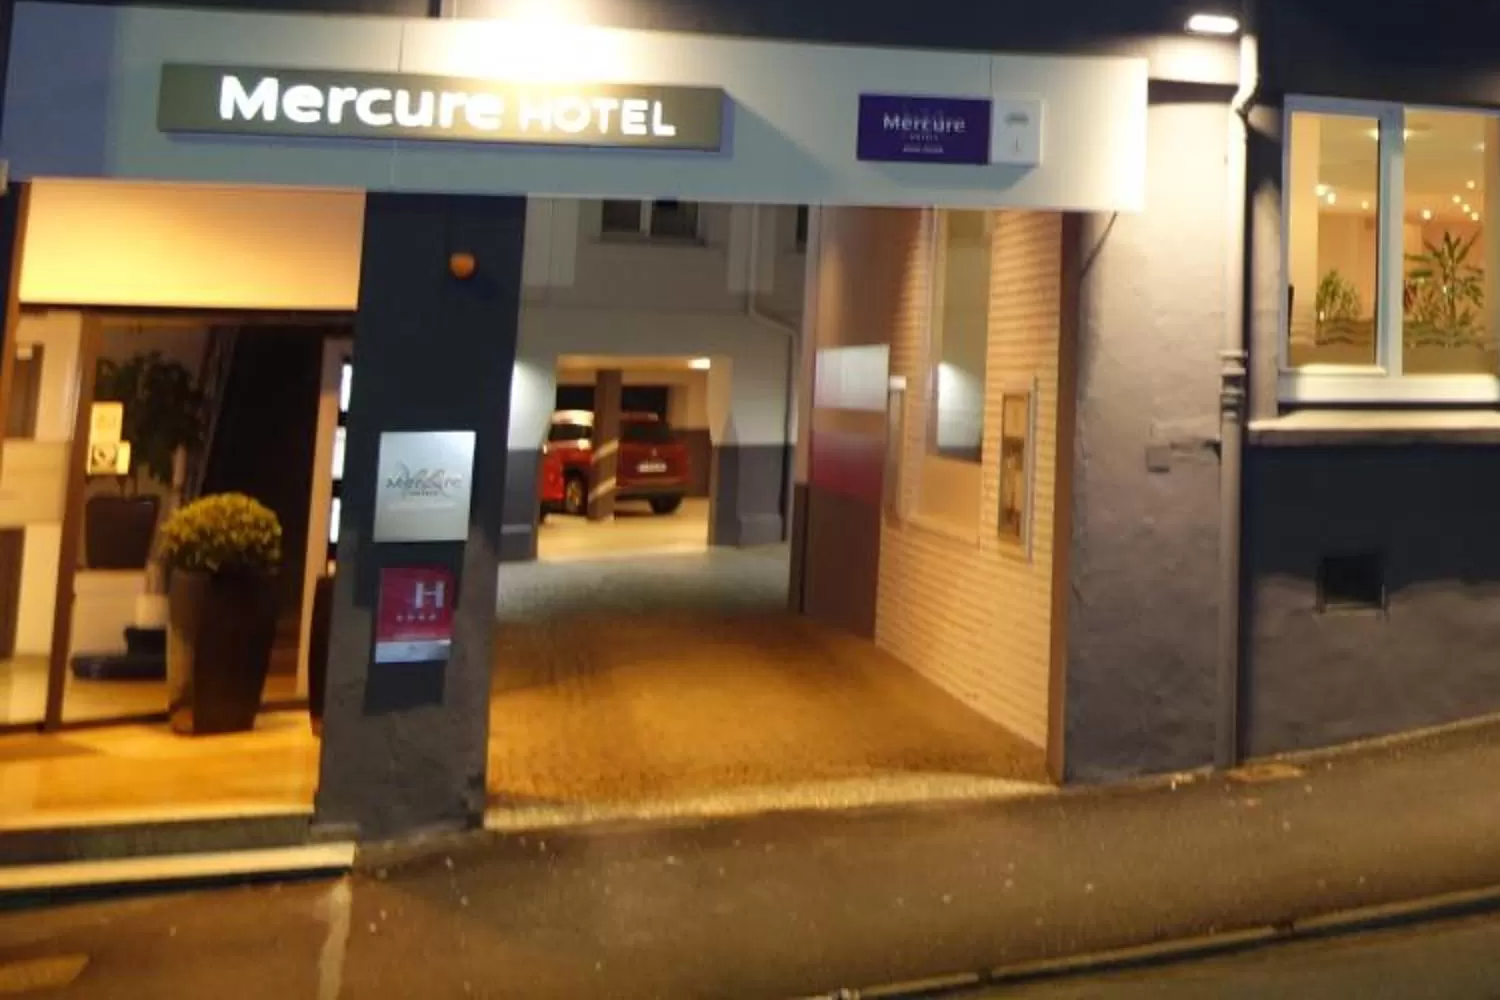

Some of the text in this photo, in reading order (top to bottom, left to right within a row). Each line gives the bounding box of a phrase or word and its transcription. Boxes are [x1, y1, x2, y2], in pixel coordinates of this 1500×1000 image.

[218, 74, 676, 137] Mercure HOTEL
[883, 111, 966, 133] Mercure
[415, 580, 445, 608] H
